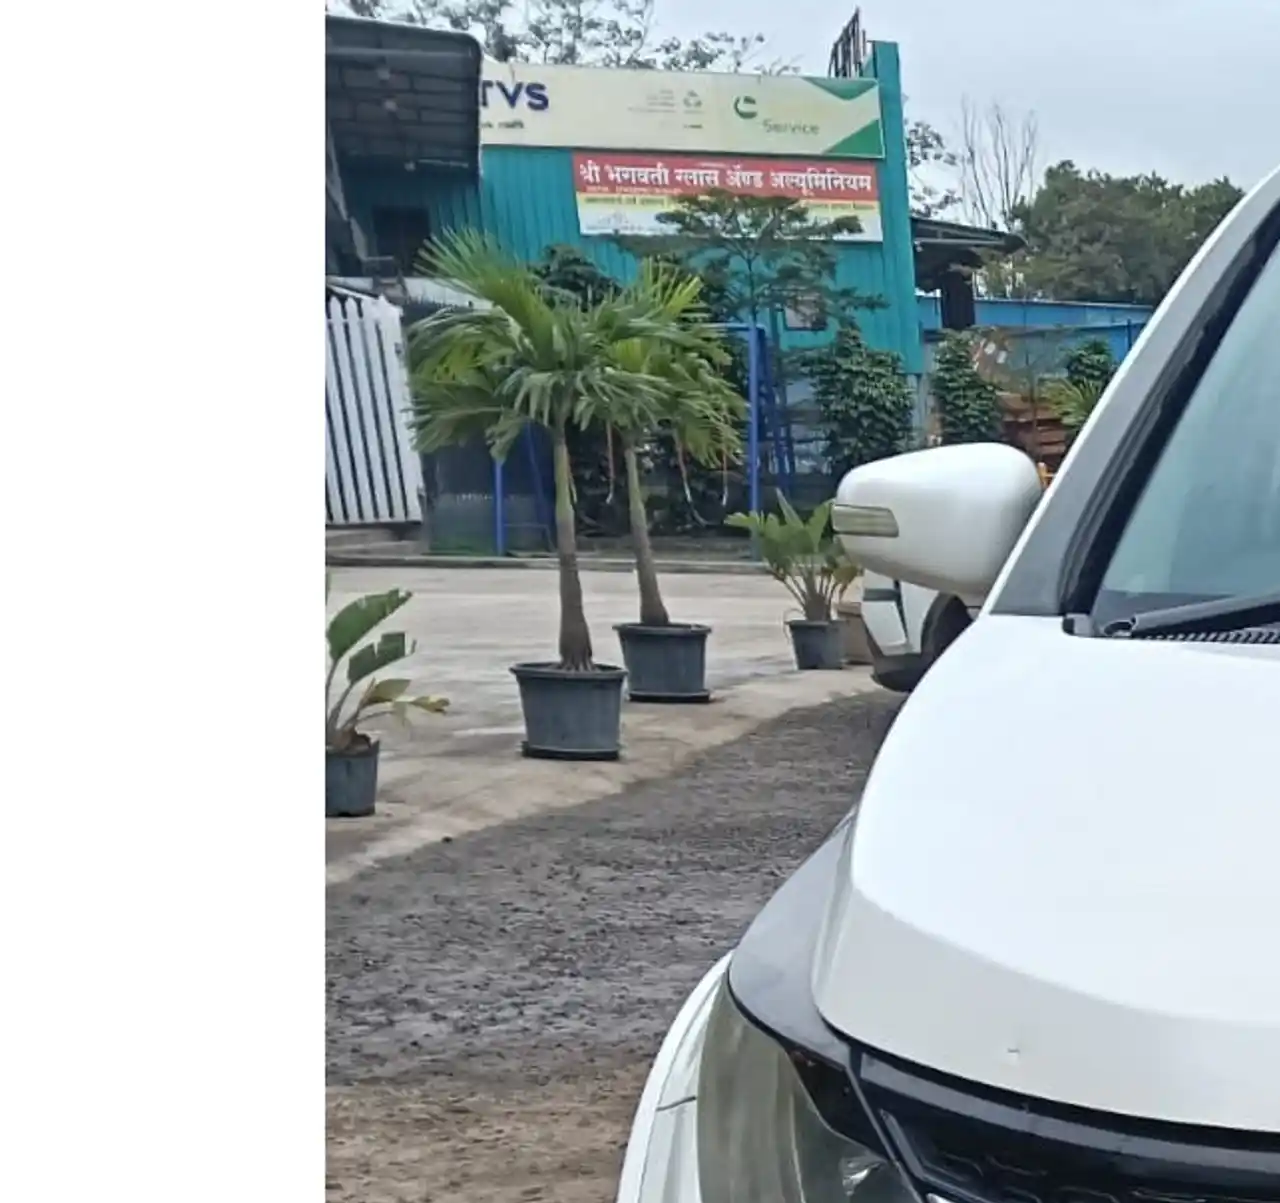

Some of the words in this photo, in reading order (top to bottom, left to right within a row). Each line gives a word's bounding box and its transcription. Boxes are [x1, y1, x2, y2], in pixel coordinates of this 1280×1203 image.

[762, 118, 820, 136] Service
[579, 159, 601, 184] श्री
[603, 162, 669, 185] भगवती
[674, 167, 719, 187] ग्लास
